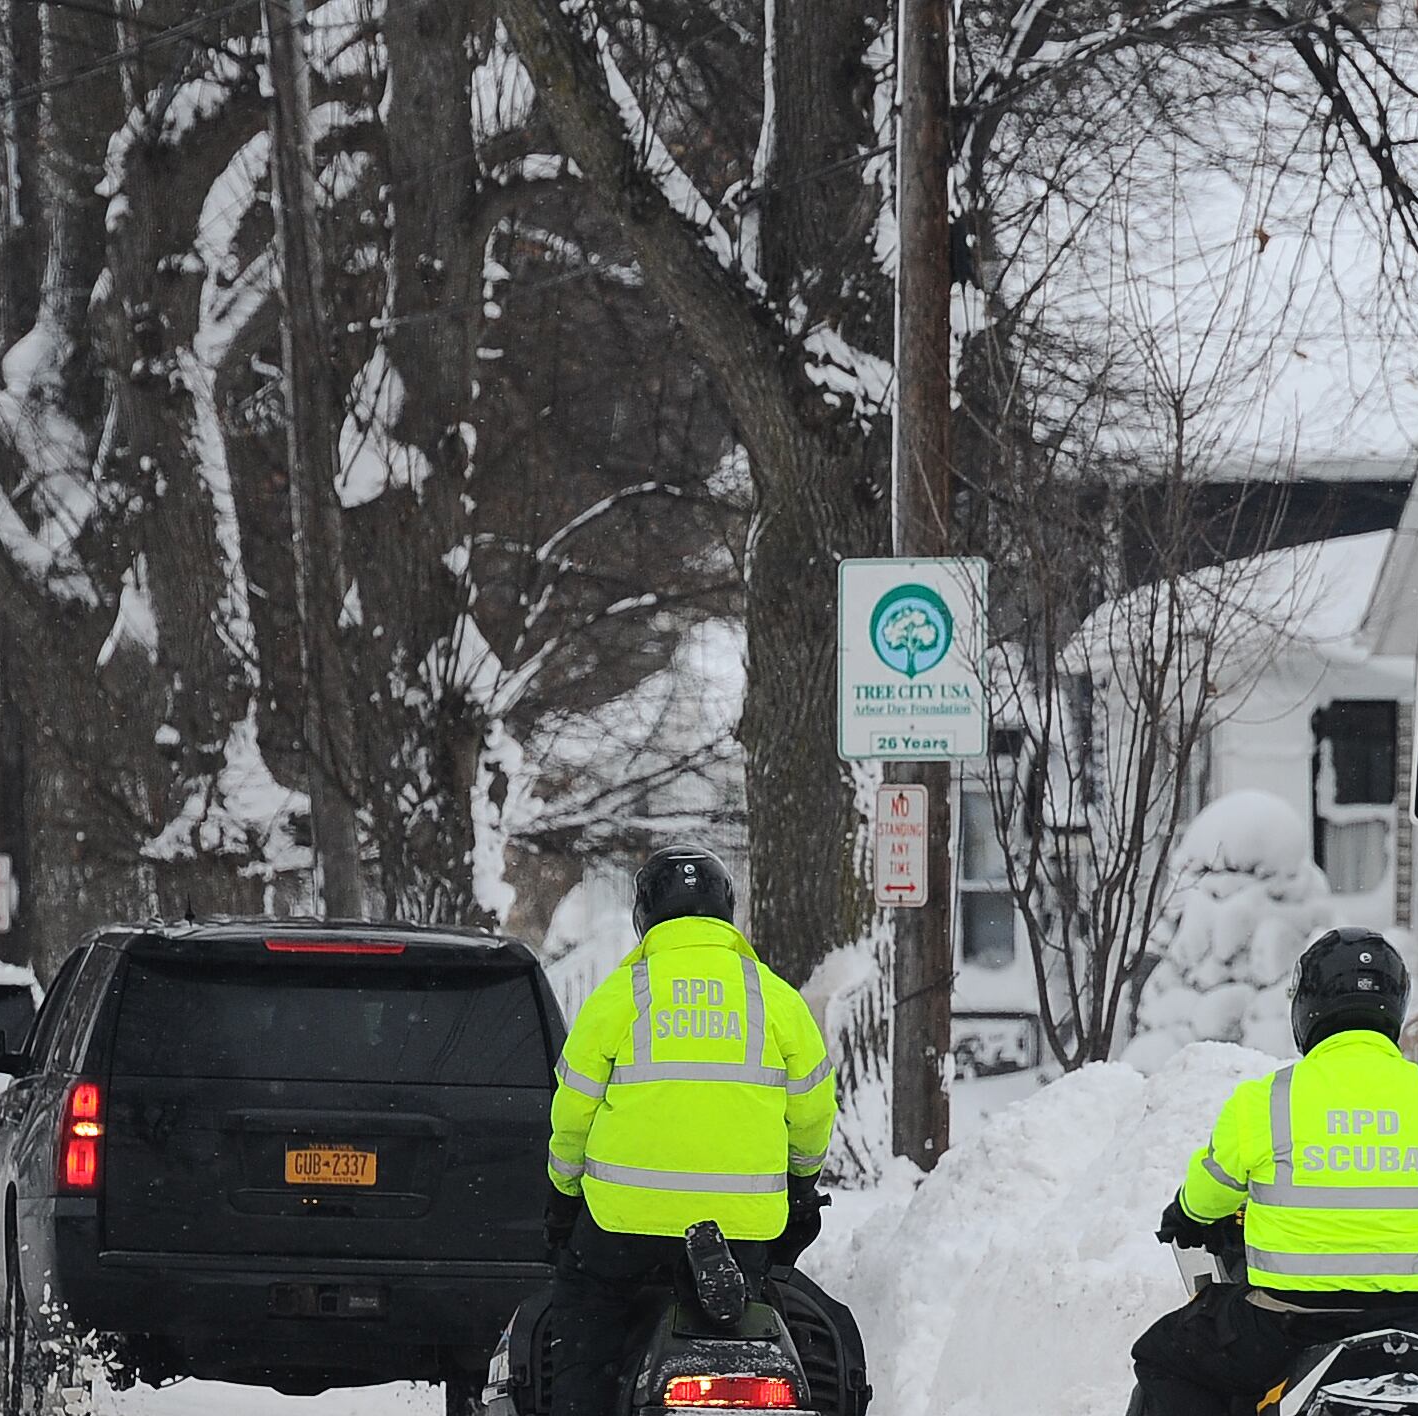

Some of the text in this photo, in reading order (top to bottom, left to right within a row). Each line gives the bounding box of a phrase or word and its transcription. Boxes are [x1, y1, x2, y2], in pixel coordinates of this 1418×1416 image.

[853, 683, 972, 700] TREE CITY USA
[853, 703, 972, 717] Arbor Day Foundation
[878, 736, 949, 750] 26 Years
[892, 797, 910, 817] NO
[879, 822, 923, 838] STANDING
[891, 842, 909, 857] ANY
[890, 861, 911, 876] TIME
[672, 978, 724, 1006] RPD
[656, 1009, 741, 1040] SCUBA
[1326, 1109, 1399, 1135] RPD
